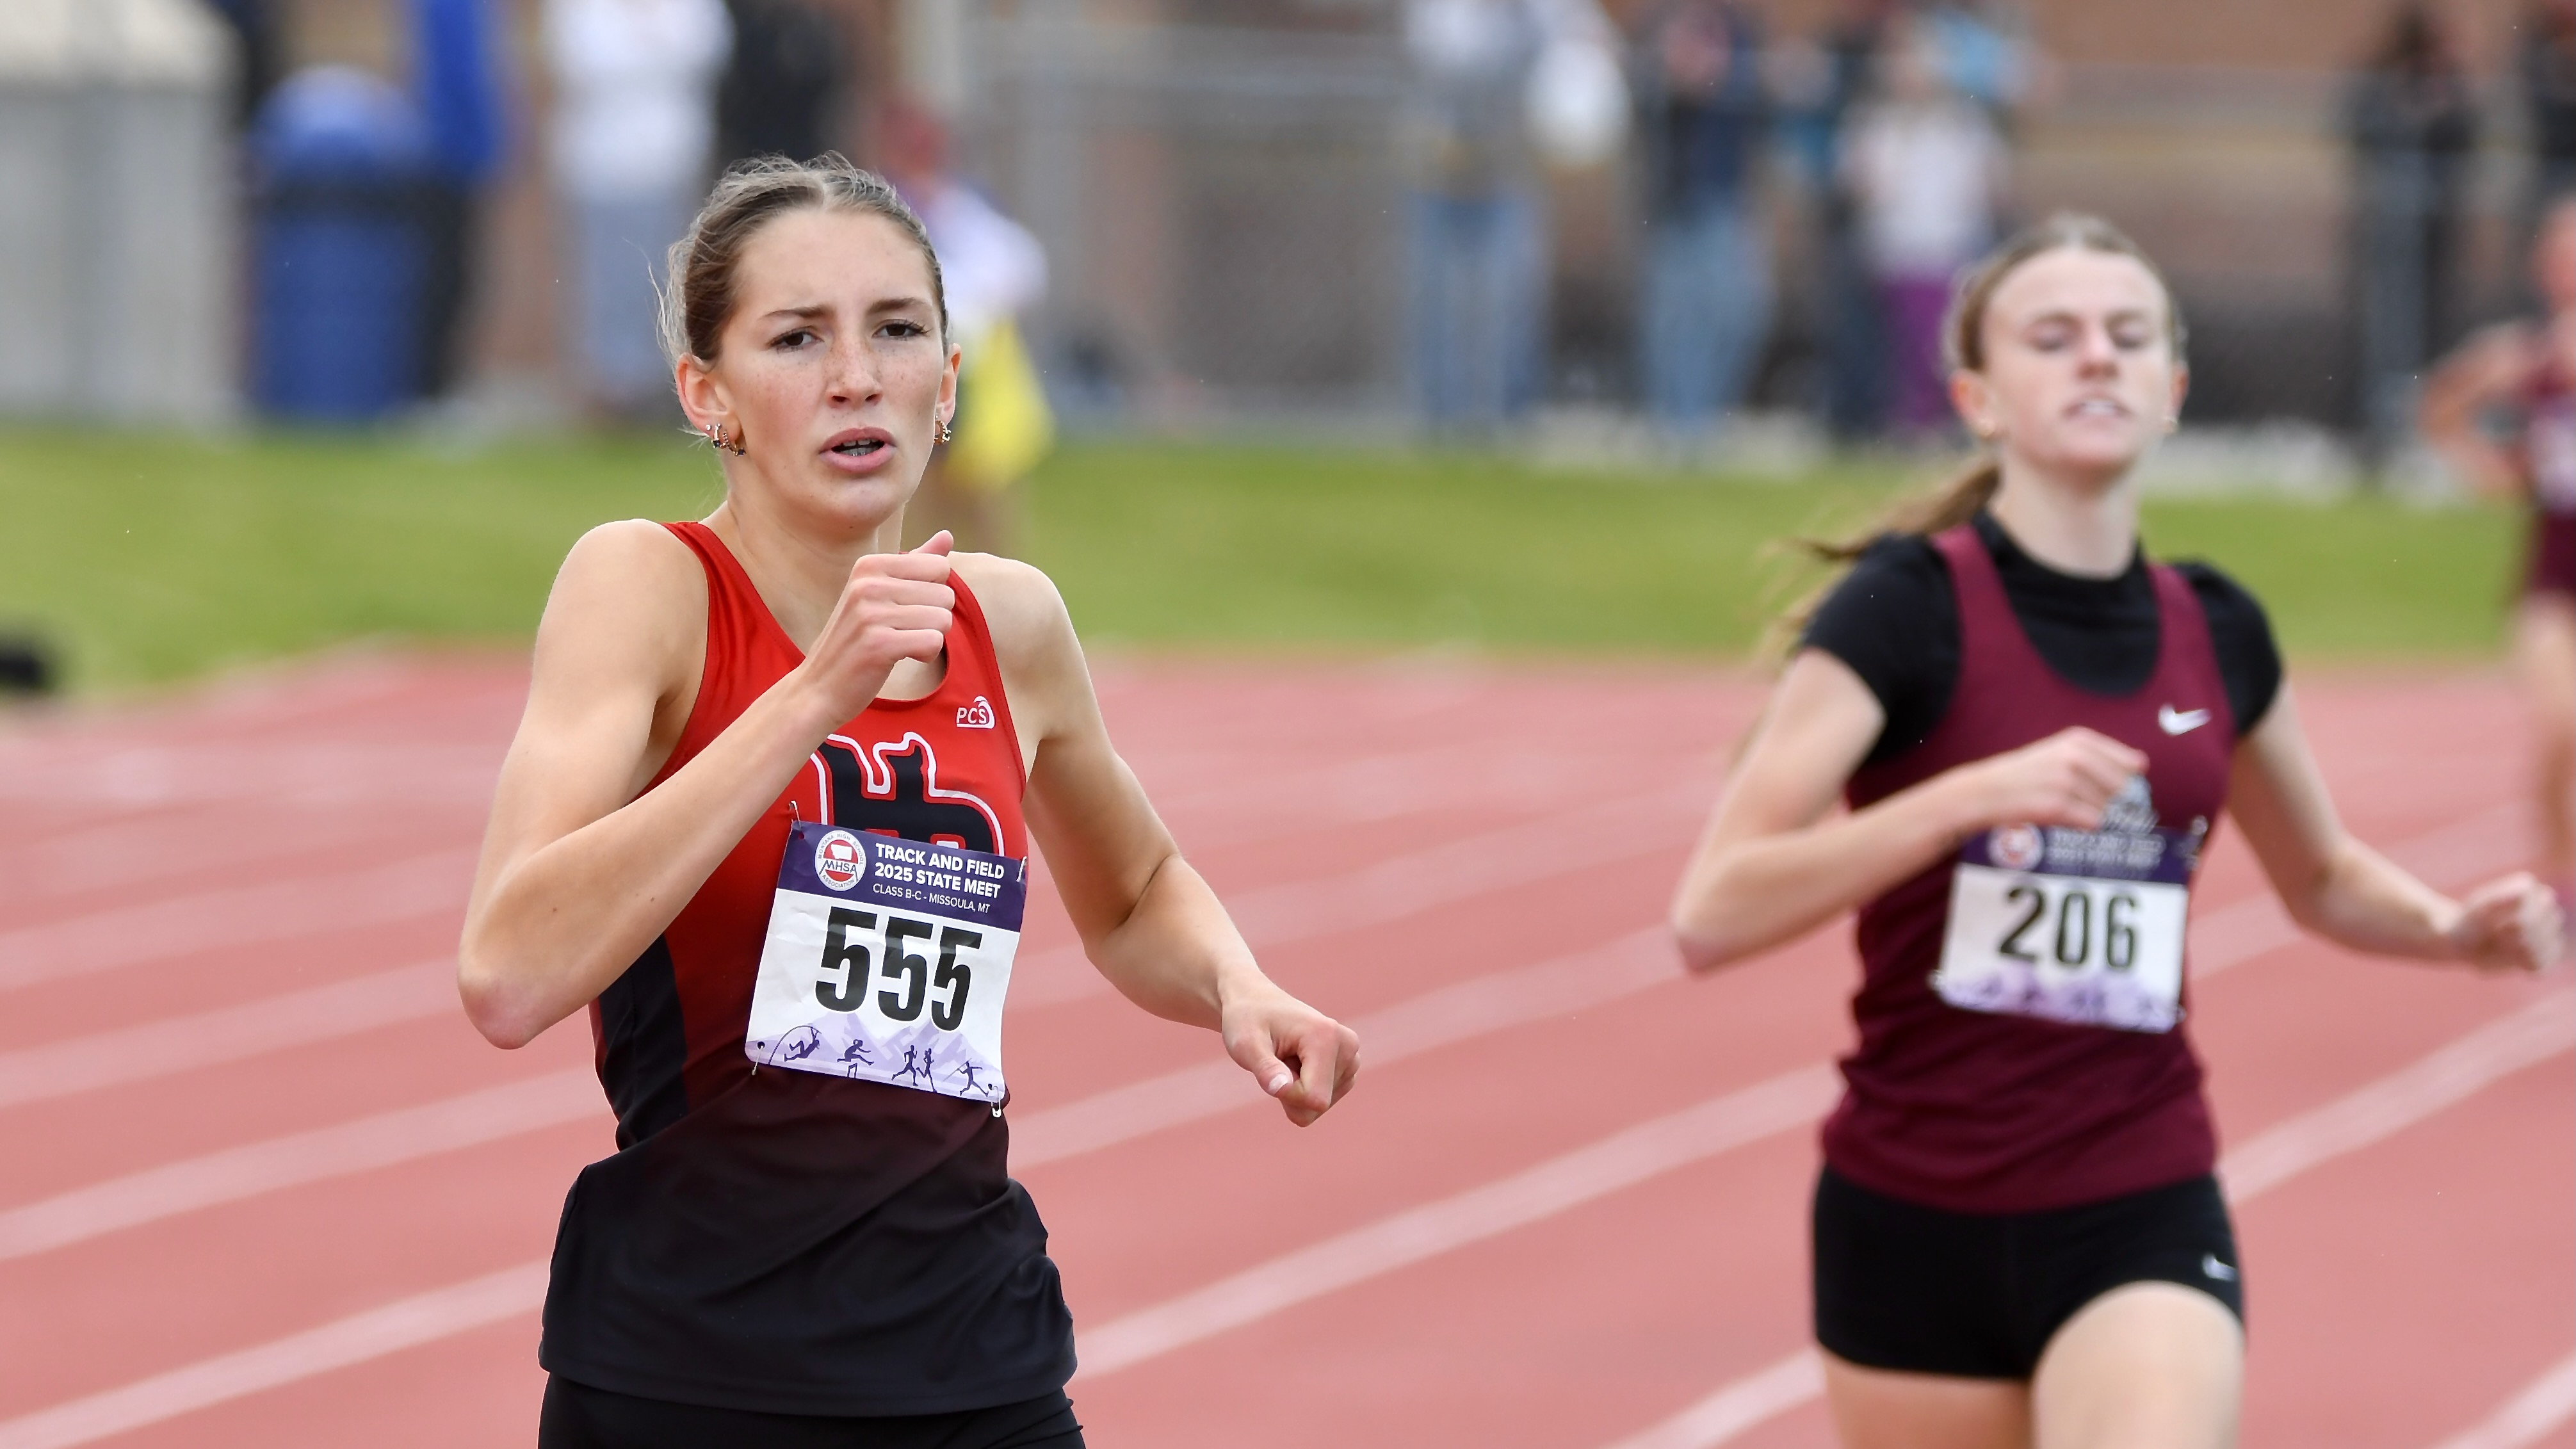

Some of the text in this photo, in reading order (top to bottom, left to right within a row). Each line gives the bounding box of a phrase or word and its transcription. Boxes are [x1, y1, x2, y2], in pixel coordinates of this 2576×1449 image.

[956, 707, 987, 724] PCS
[818, 835, 834, 859] MONTANA
[852, 841, 864, 865] SCHOOL
[875, 843, 1005, 880] TRACK AND FIELD
[818, 859, 859, 882] MHSA
[822, 875, 855, 888] ASSOCIATION
[874, 862, 1001, 898] 2025 STATE MEET
[873, 883, 903, 897] CLASS
[905, 889, 921, 901] B-C
[928, 893, 976, 912] MISSOULA,
[978, 902, 991, 914] MT
[1998, 886, 2137, 969] 206
[815, 905, 983, 1032] 555
